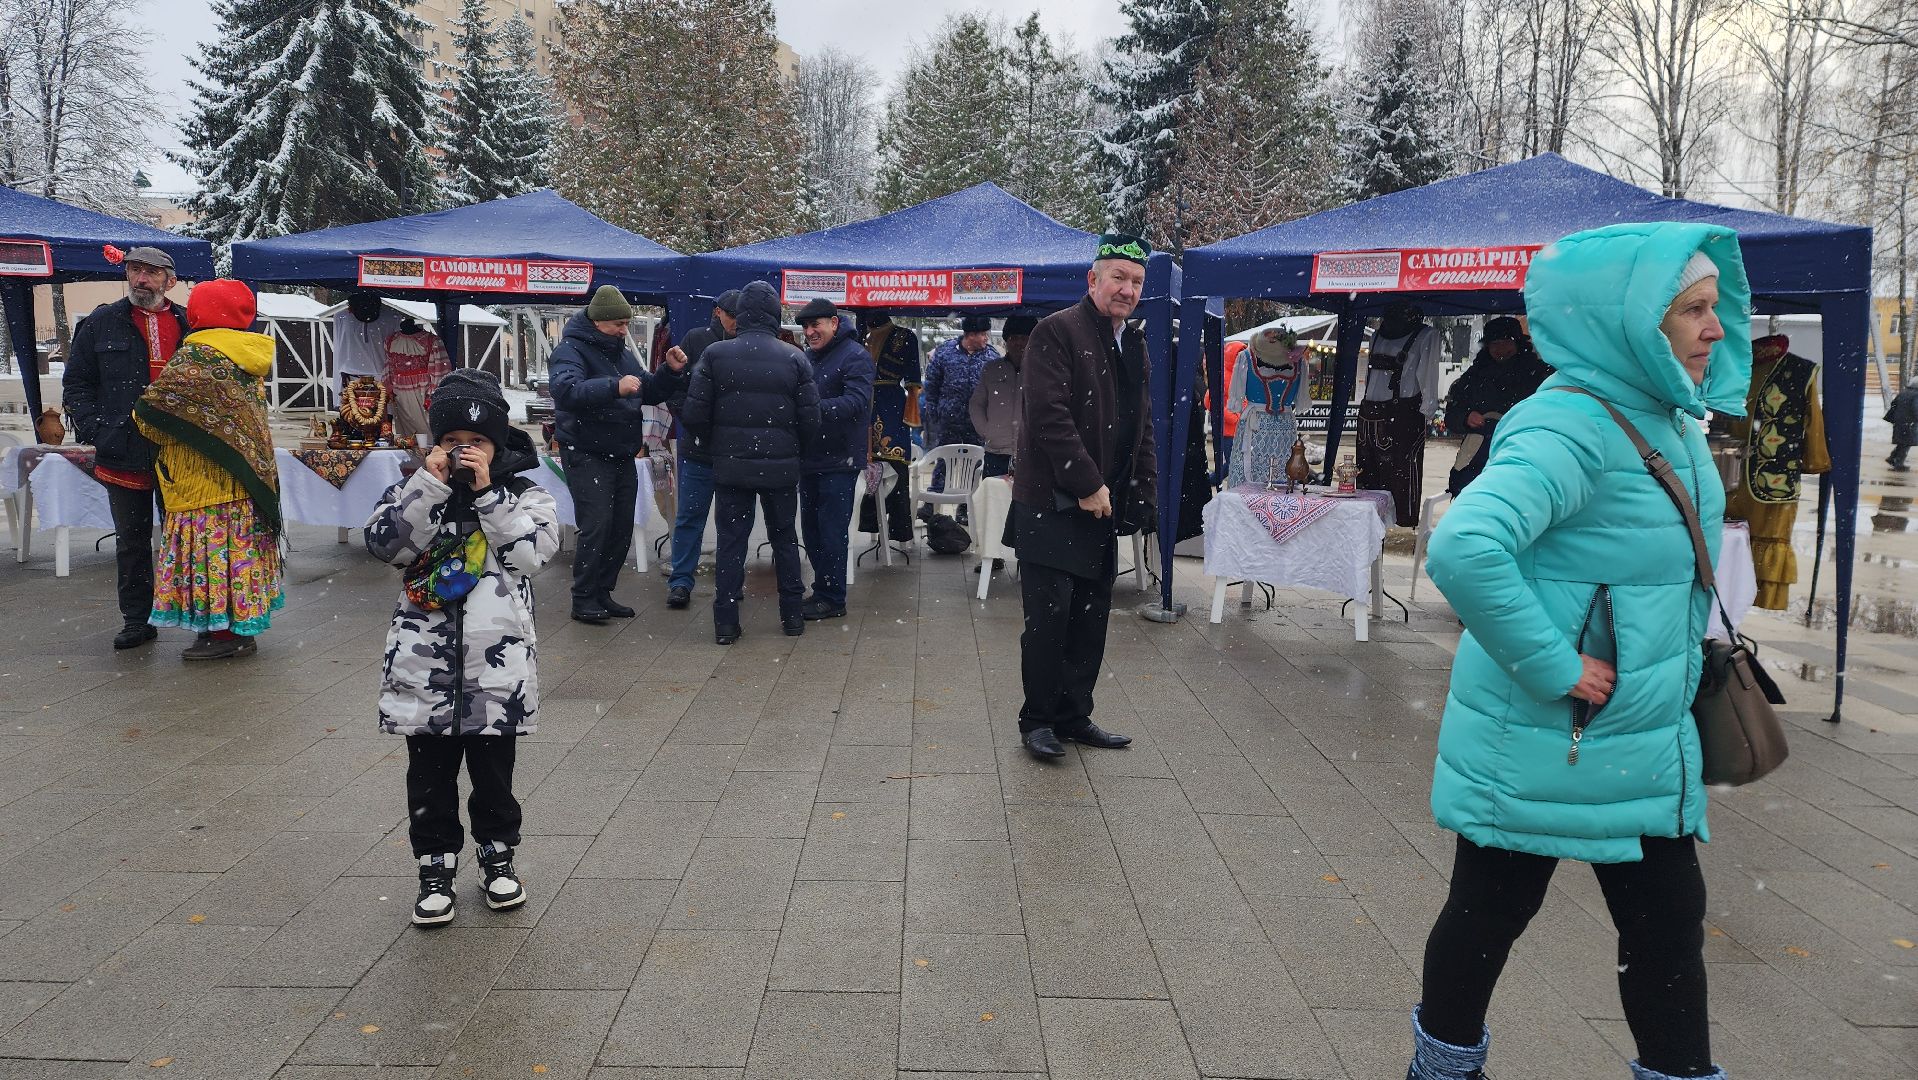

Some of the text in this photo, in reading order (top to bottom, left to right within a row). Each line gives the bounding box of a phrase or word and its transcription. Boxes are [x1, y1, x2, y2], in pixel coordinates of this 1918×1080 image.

[1407, 250, 1537, 269] САМОВАРНА
[429, 260, 522, 276] САМОВАРНАЯ
[446, 275, 506, 289] станция
[852, 273, 947, 288] САМОВАРНАЯ
[1428, 270, 1517, 286] станция
[866, 289, 930, 304] станция
